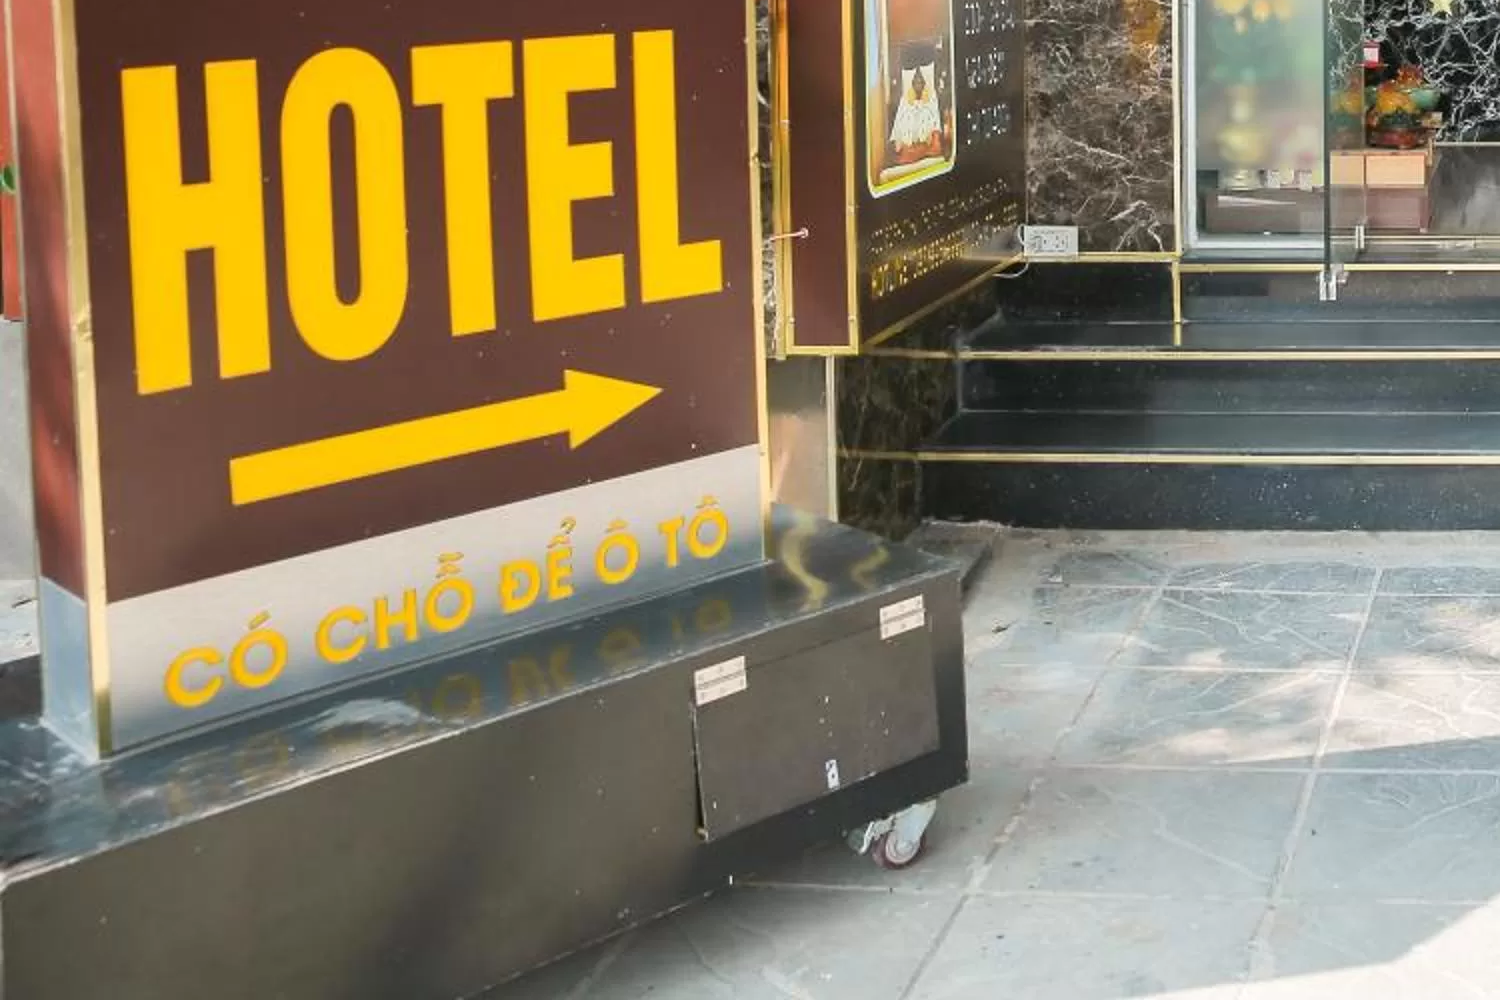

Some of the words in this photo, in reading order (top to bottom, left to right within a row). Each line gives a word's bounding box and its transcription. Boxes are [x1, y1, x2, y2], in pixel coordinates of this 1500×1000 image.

[120, 28, 723, 396] HOTEL
[163, 612, 288, 708] CÓ
[314, 552, 474, 665] CHỖ
[498, 515, 577, 615] ĐỂ
[595, 519, 640, 585] Ô
[657, 495, 730, 568] TÔ
